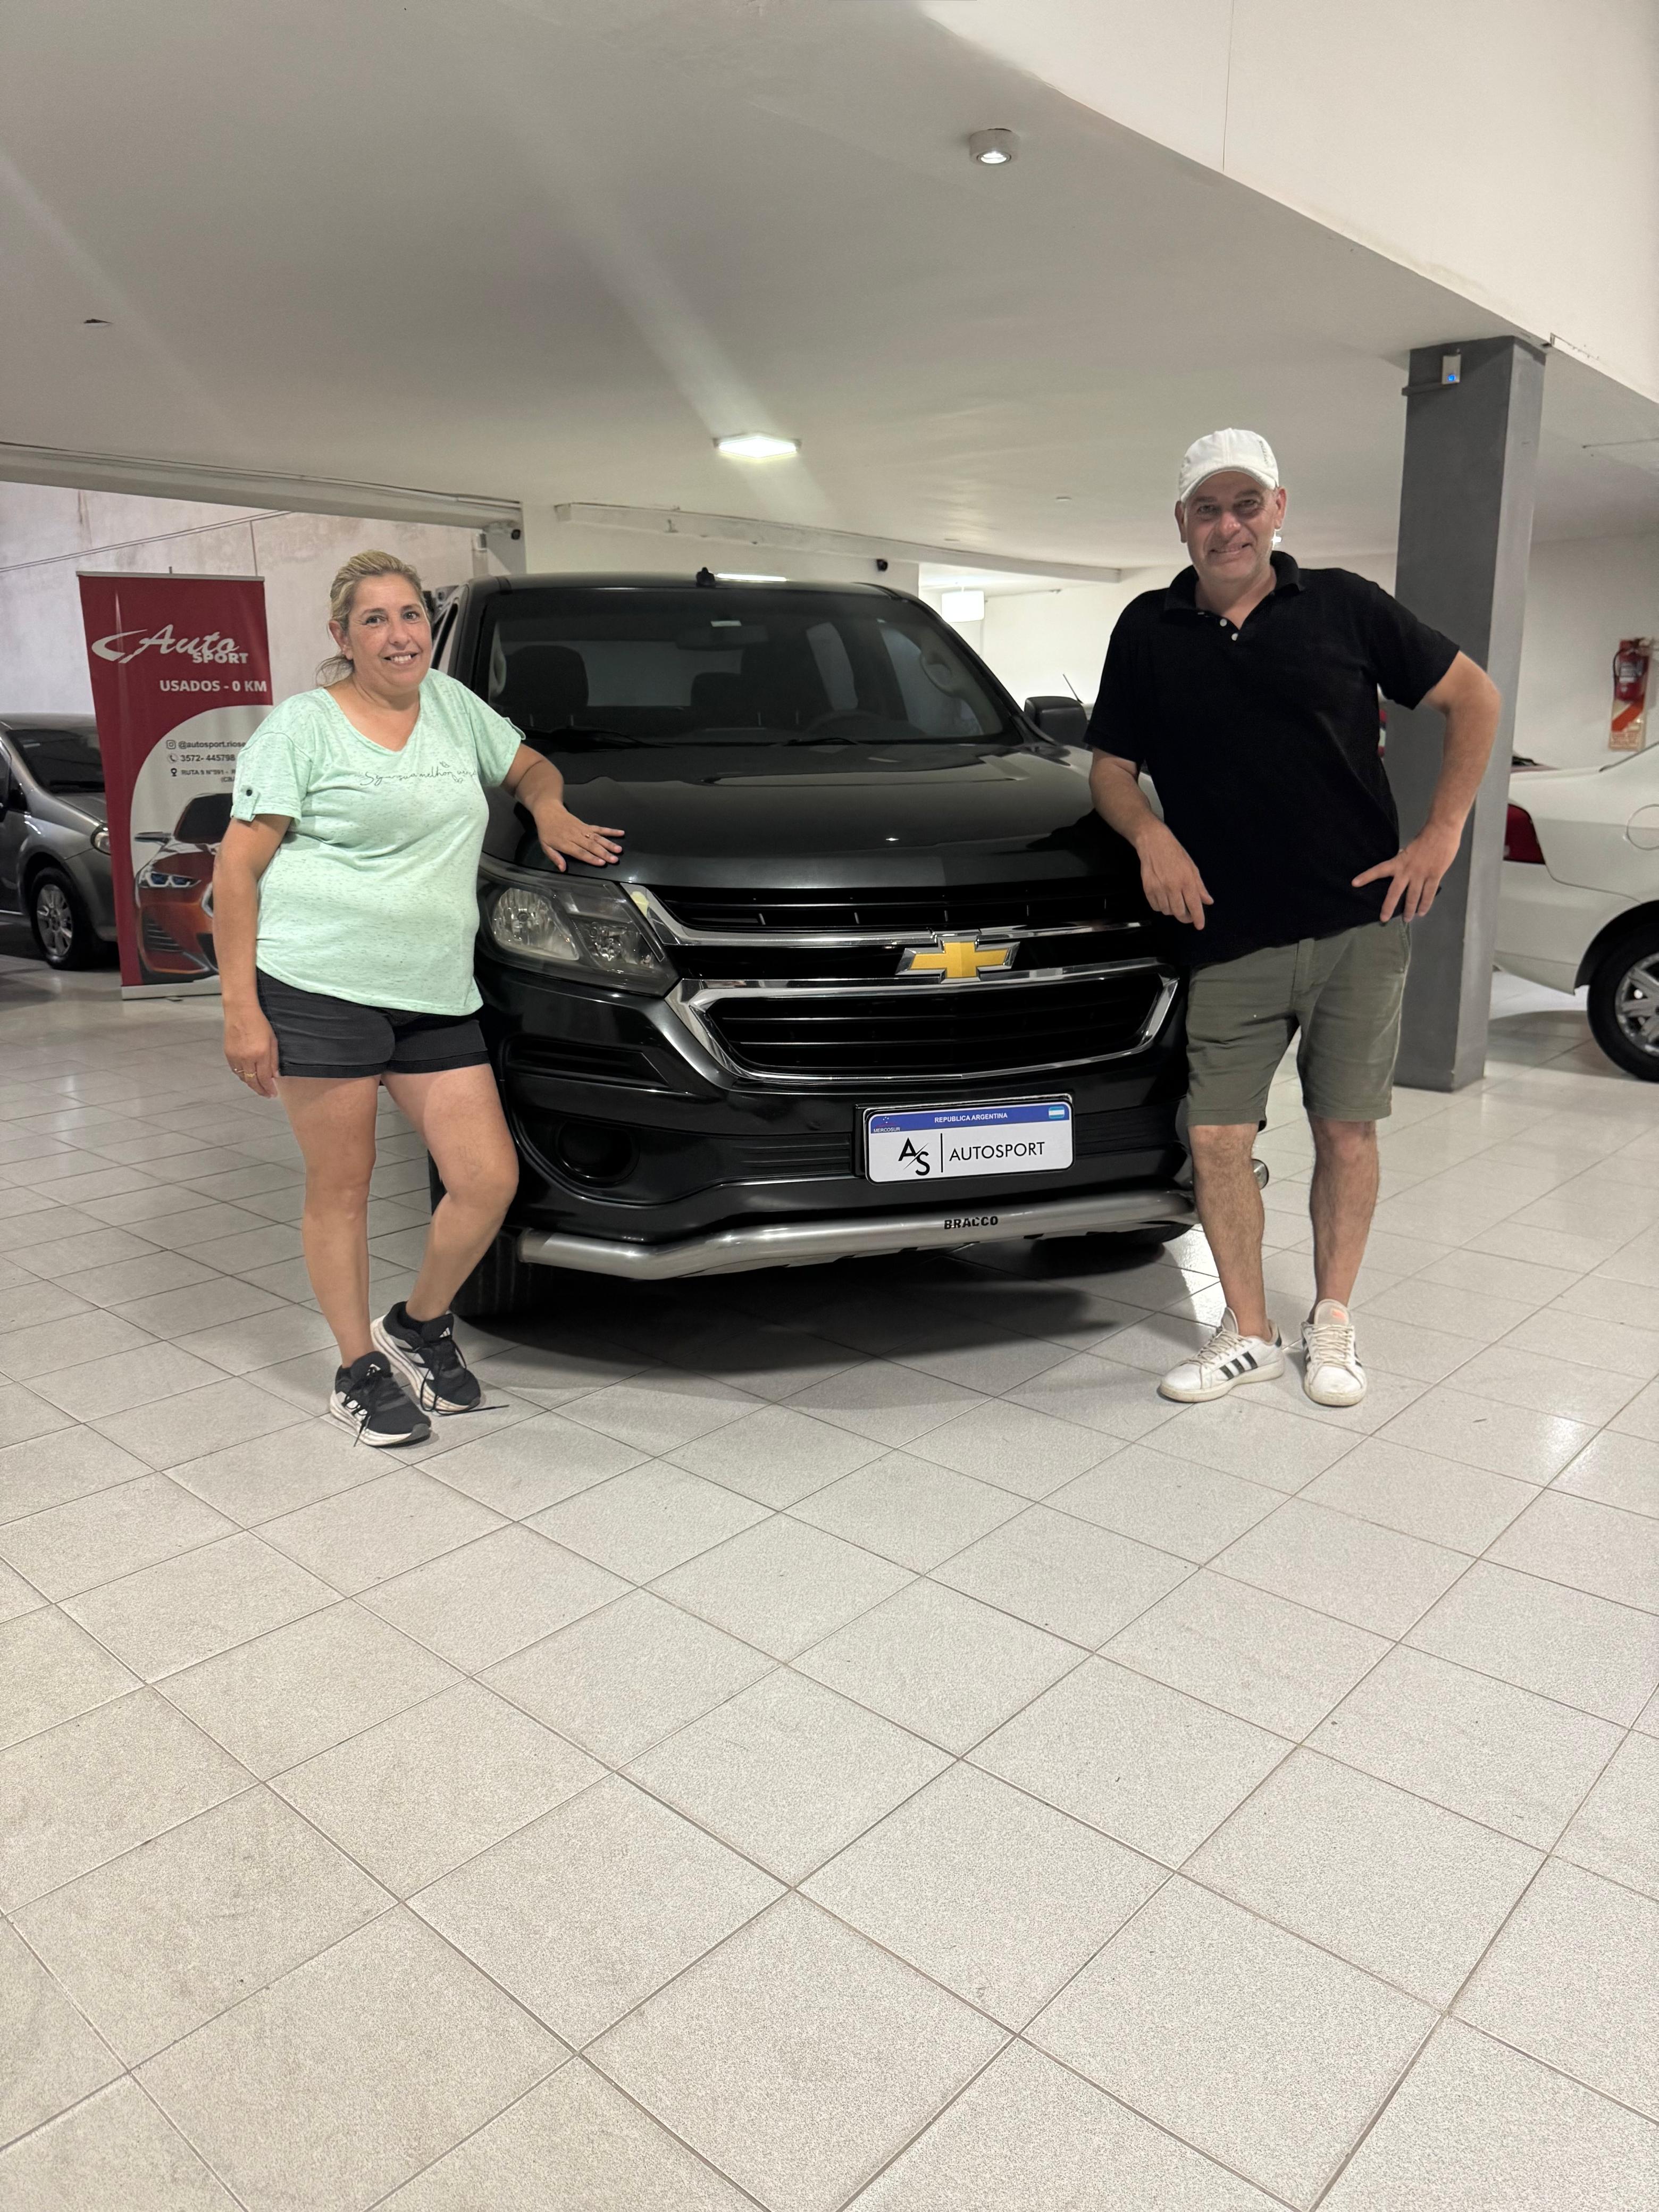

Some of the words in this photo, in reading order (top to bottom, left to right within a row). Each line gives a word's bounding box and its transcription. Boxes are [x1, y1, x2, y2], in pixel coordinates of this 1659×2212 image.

[133, 624, 239, 655] Auto
[192, 652, 249, 664] SPORT
[160, 680, 221, 692] USADOS
[232, 681, 241, 691] 0
[244, 680, 267, 692] KM
[971, 1112, 1008, 1121] ARGENTINA
[949, 1142, 1045, 1162] AUTOSPORT
[944, 1216, 999, 1230] BRACCO
